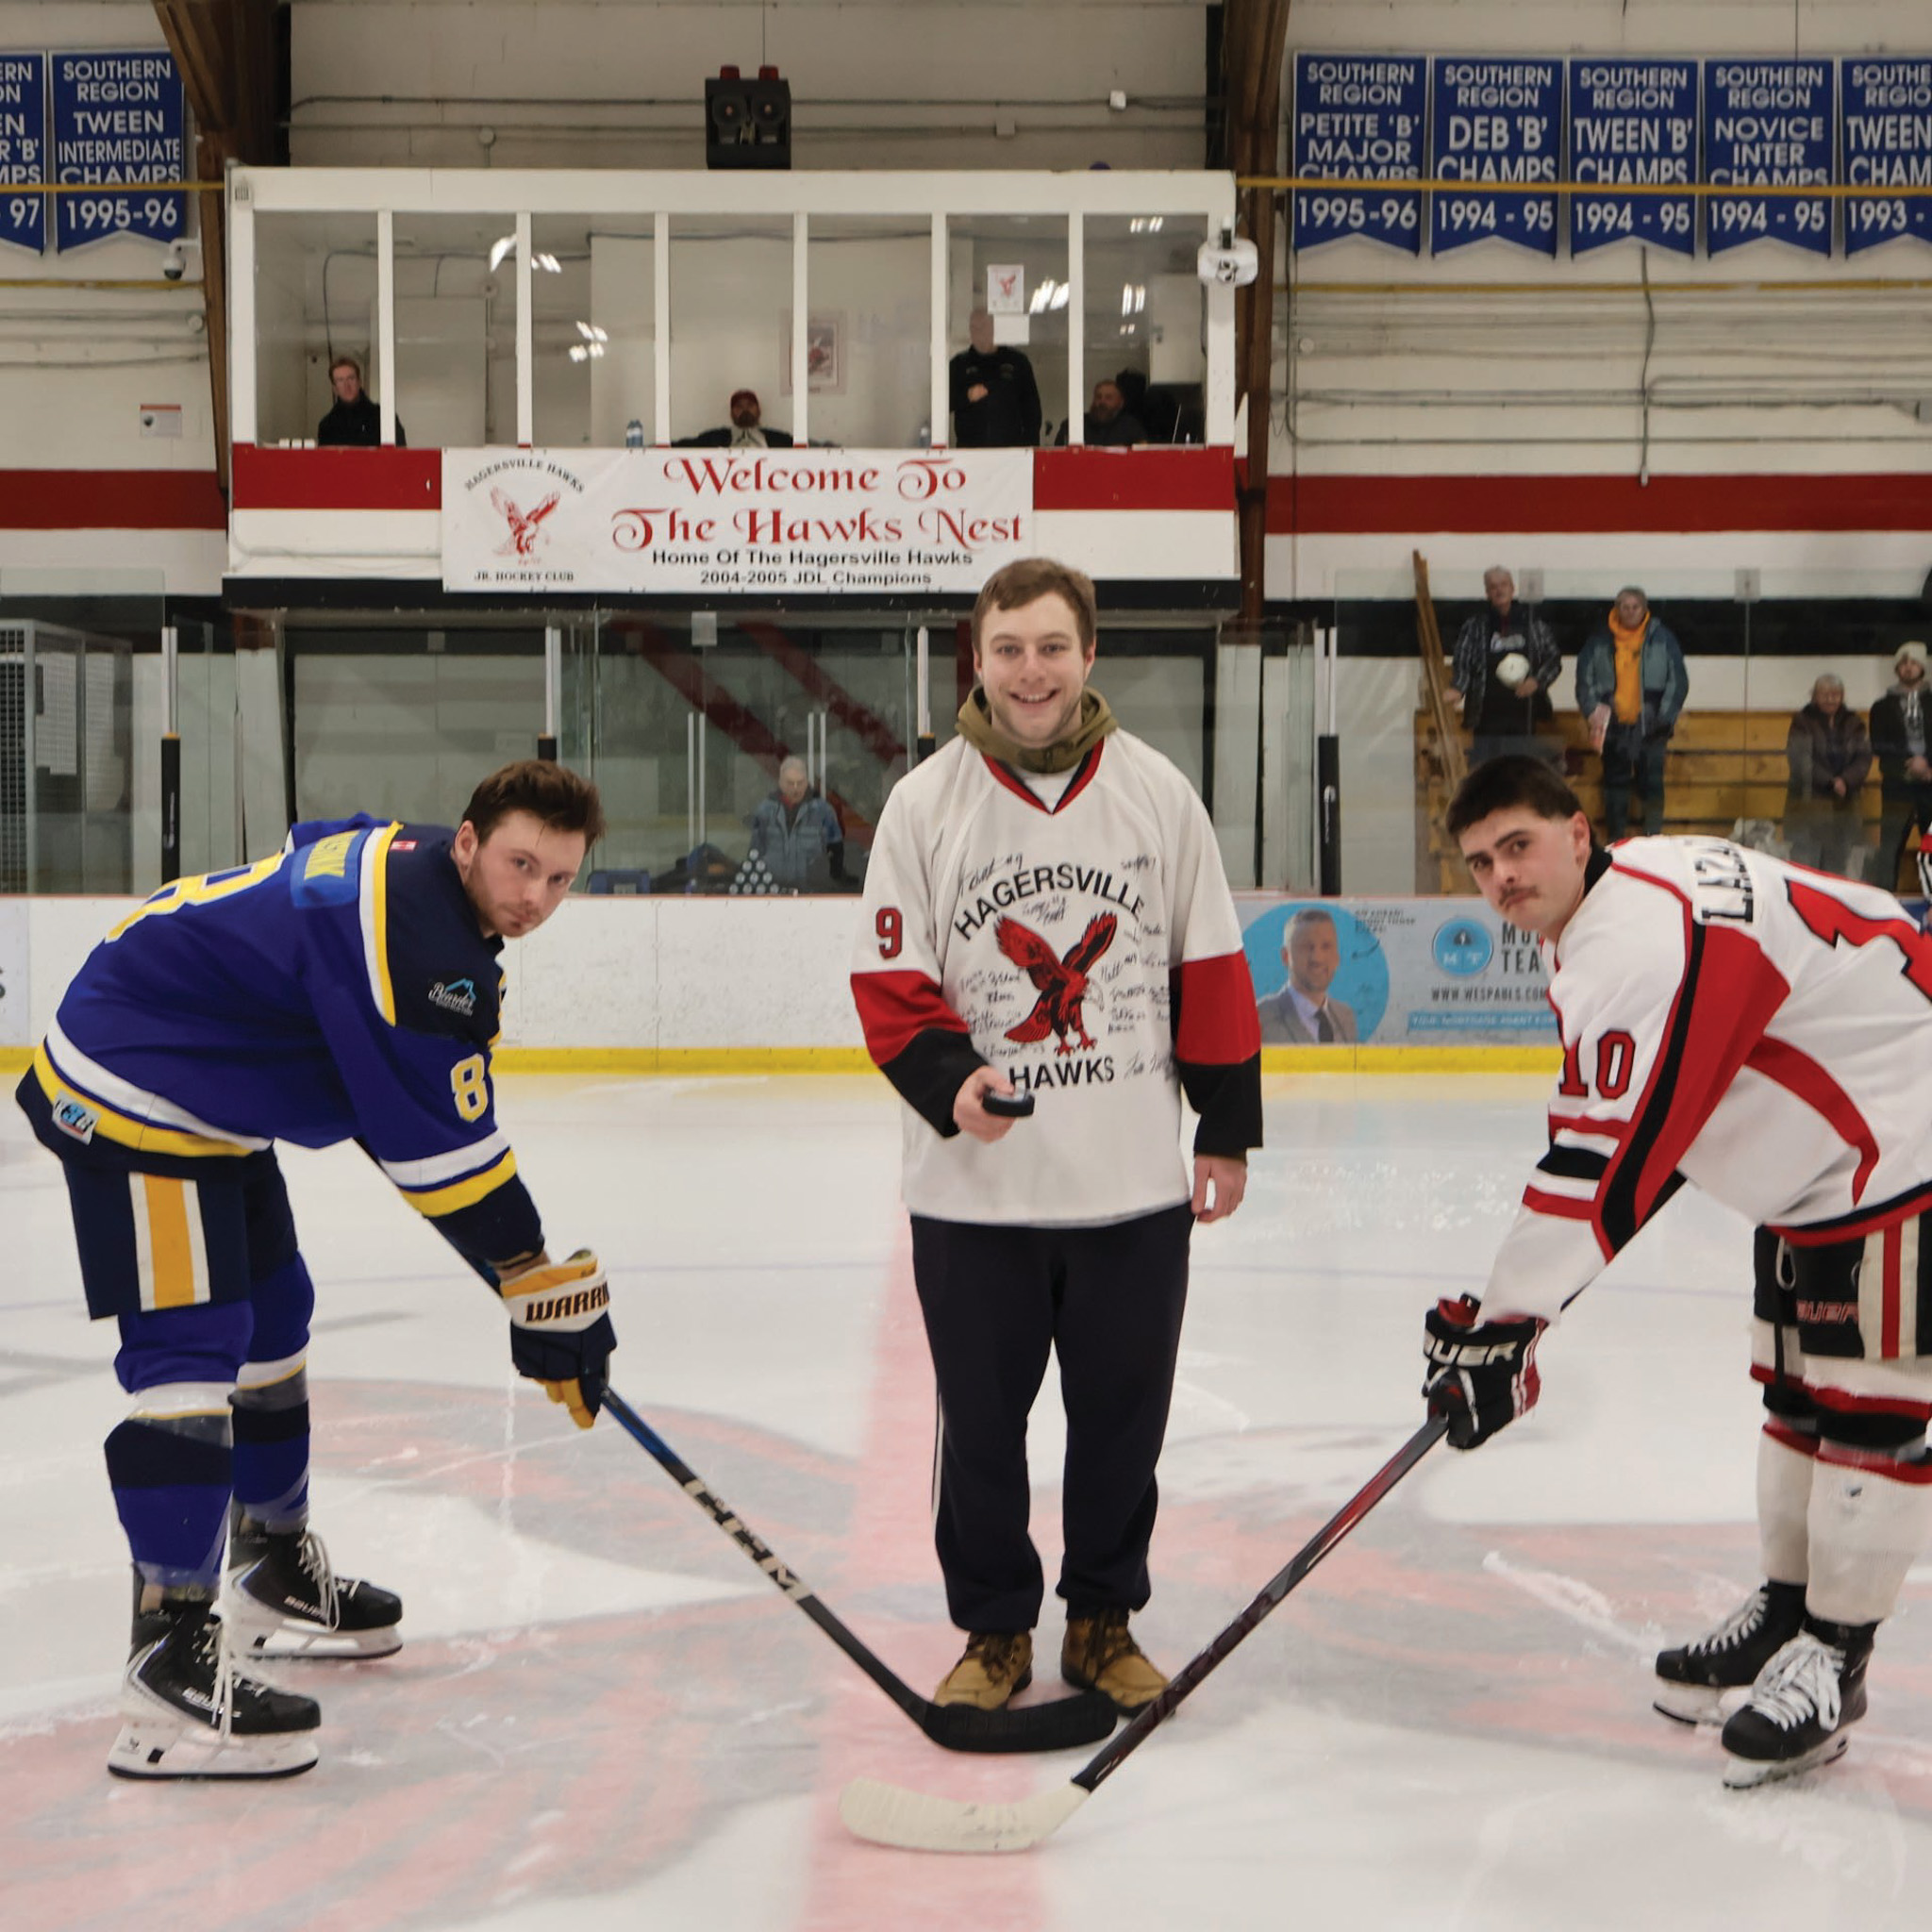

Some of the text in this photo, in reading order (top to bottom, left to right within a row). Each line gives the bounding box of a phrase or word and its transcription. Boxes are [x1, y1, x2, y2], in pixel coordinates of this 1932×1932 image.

[0, 62, 33, 82] RN
[63, 59, 171, 81] SOUTHERN
[1307, 63, 1414, 85] SOUTHERN
[1444, 65, 1552, 87] SOUTHERN
[1580, 67, 1687, 90] SOUTHERN
[1716, 66, 1823, 89] SOUTHERN
[1852, 64, 1932, 87] SOUTHE
[77, 81, 159, 103] REGION
[1320, 84, 1401, 106] REGION
[1457, 87, 1539, 108] REGION
[1593, 89, 1674, 109] REGION
[1728, 88, 1810, 109] REGION
[1865, 86, 1932, 108] REGIO
[74, 110, 164, 134] TWEEN
[1300, 113, 1419, 138] PETITE 'B'
[1449, 116, 1548, 151] DEB 'B'
[1715, 117, 1824, 142] NOVICE
[1846, 114, 1932, 151] TWEEN
[1574, 118, 1692, 152] TWEEN 'B'
[16, 139, 40, 162] 'B'
[58, 139, 180, 164] INTERMEDIATE
[1308, 140, 1410, 163] MAJOR
[1733, 142, 1806, 167] INTER
[59, 164, 181, 183] CHAMPS
[1299, 164, 1419, 180] CHAMPS
[1438, 157, 1555, 182] CHAMPS
[1576, 158, 1687, 183] CHAMPS
[1710, 168, 1828, 186] CHAMPS
[66, 198, 177, 229] 1995-96
[464, 458, 585, 493] HAGERSVILLE HAWKS
[663, 457, 966, 501] Welcome To
[611, 508, 1023, 552] The Hawks Nest
[653, 550, 973, 568] Home Of The Hagersville Hawks
[495, 571, 541, 581] HOCKEY
[545, 571, 575, 581] CLUB
[701, 571, 931, 587] 2004-2005 JDL Champions
[954, 862, 1145, 941] HAGERSVILLE
[875, 906, 903, 960] 9
[1008, 1056, 1115, 1091] HAWKS
[1558, 1028, 1636, 1100] 10
[450, 1053, 489, 1123] 8
[525, 1280, 610, 1323] WARRI
